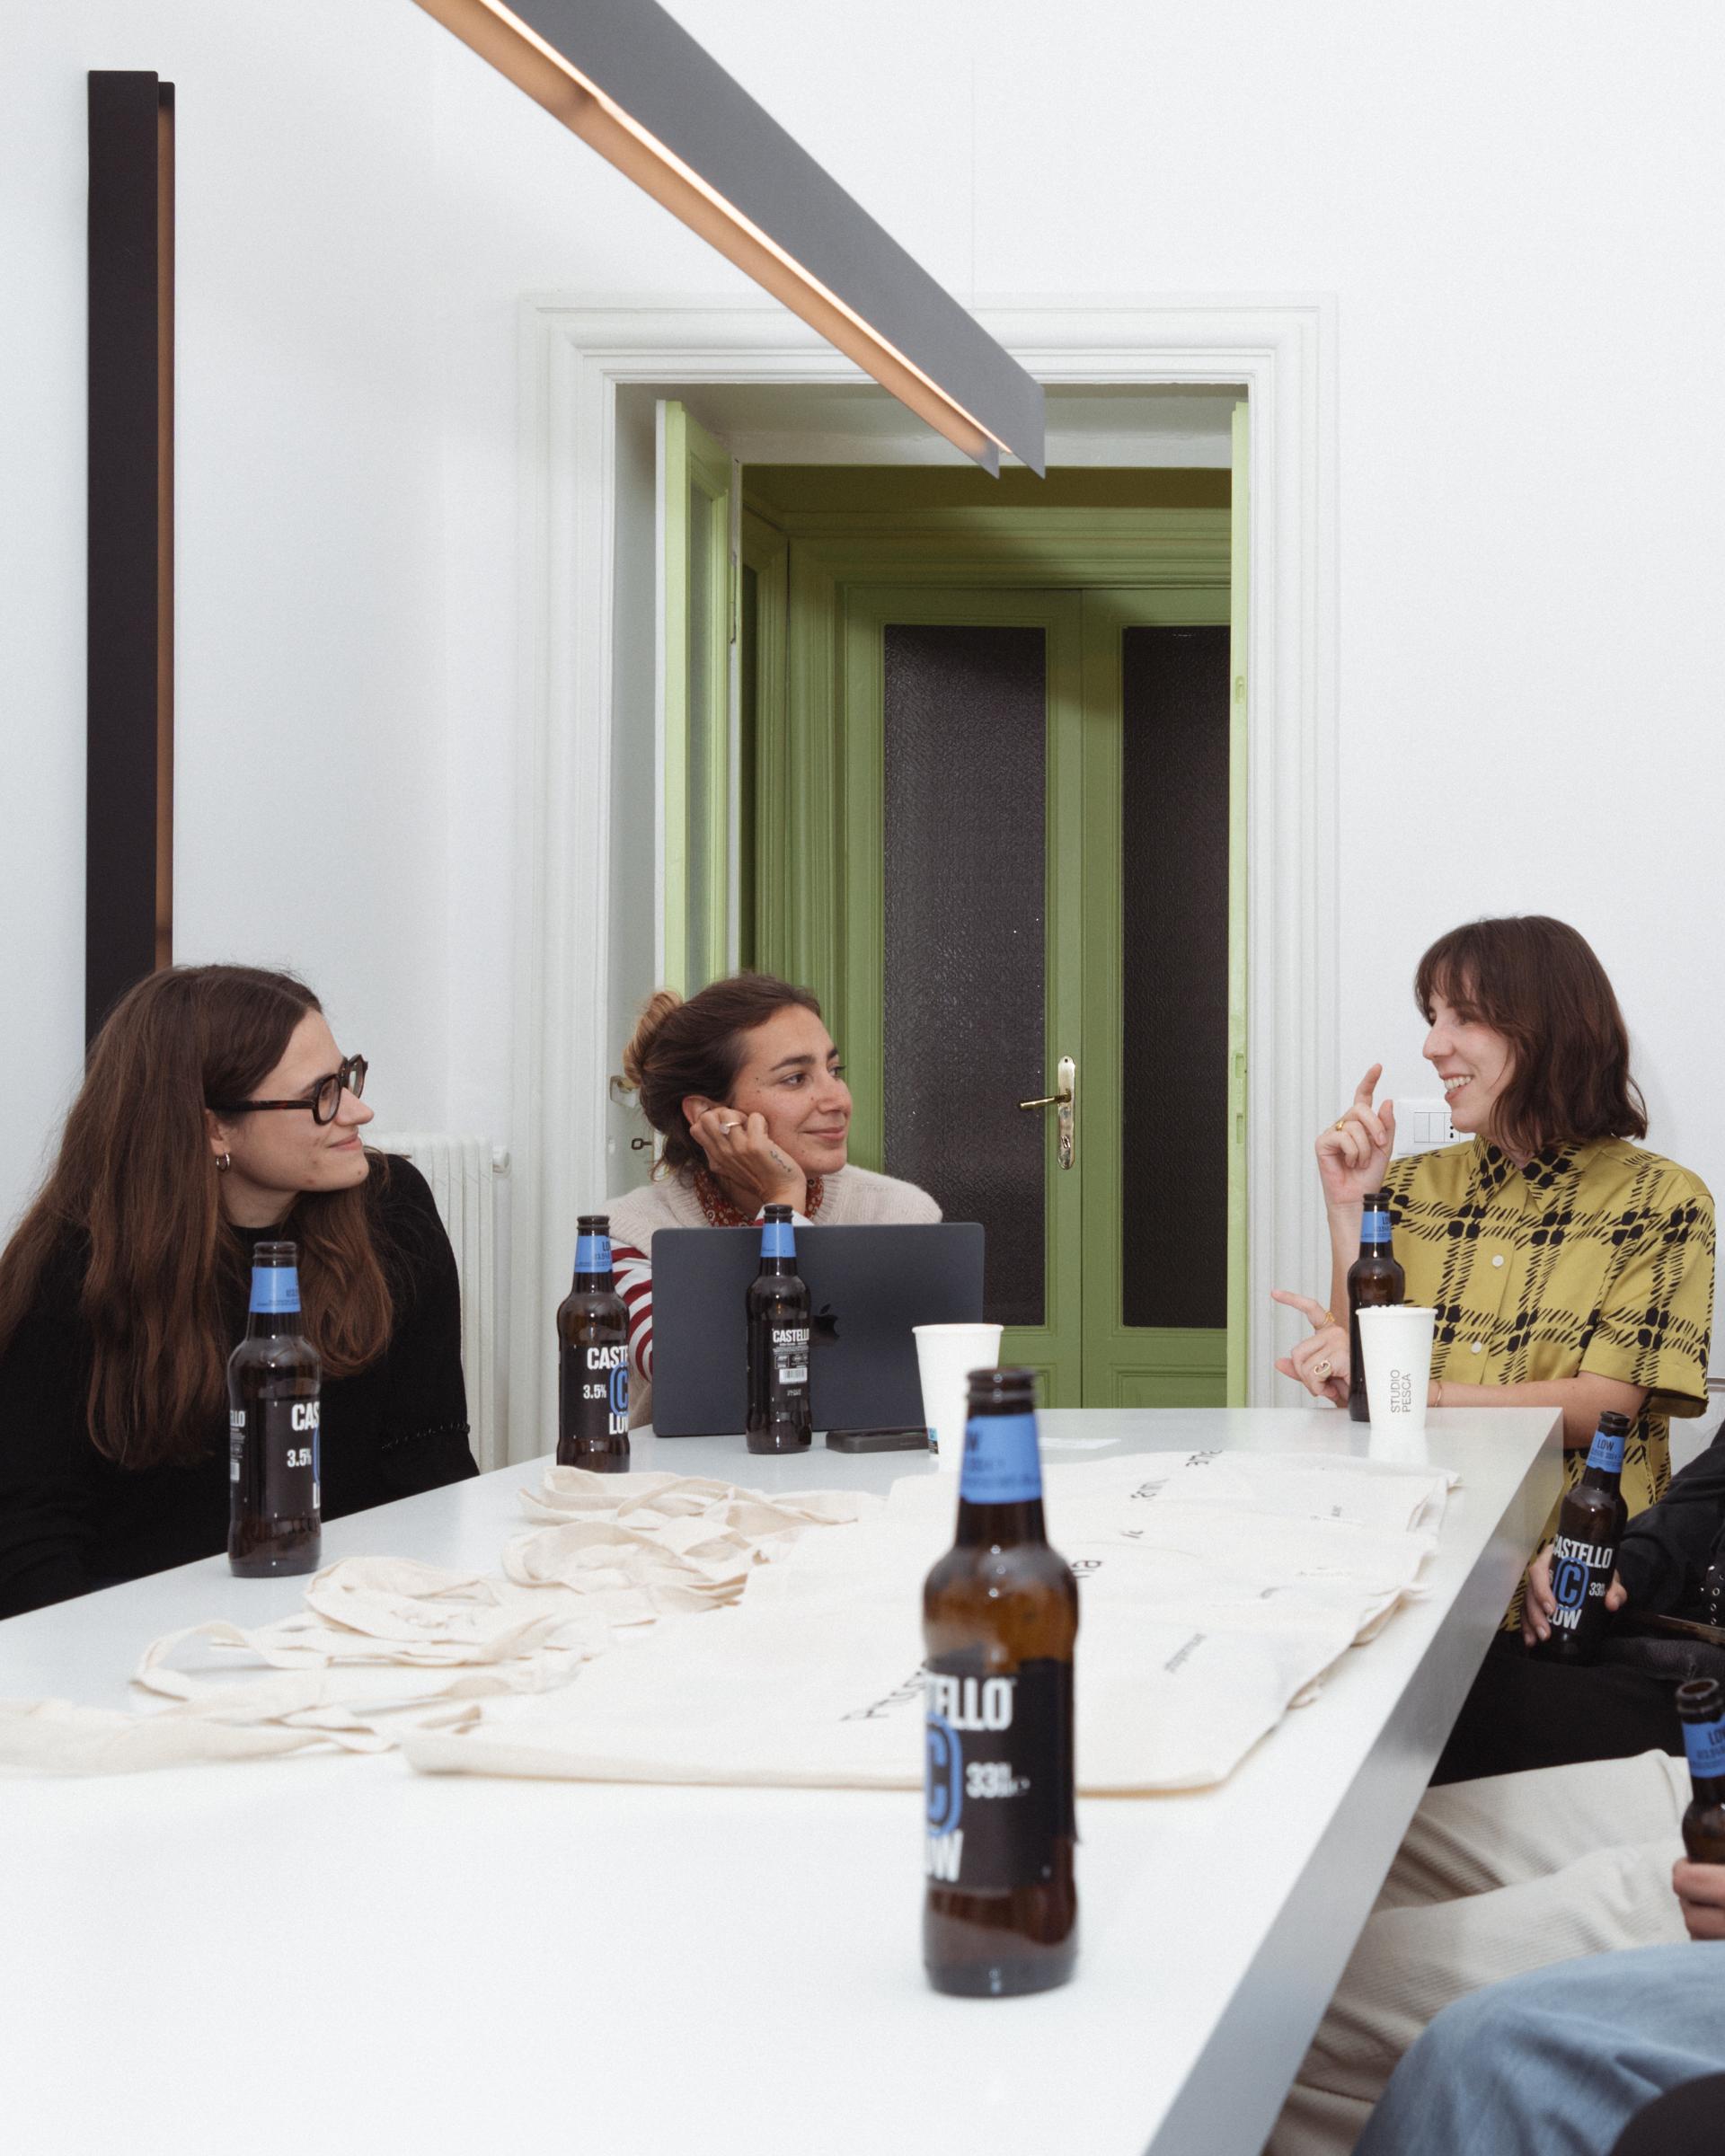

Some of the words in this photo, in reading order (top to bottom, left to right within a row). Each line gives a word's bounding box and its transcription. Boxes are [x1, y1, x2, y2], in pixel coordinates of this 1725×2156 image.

[582, 1383, 606, 1400] 3.5%
[1390, 1369, 1401, 1413] STUDIO
[1402, 1373, 1411, 1413] PESCA
[1597, 1438, 1614, 1452] LOW
